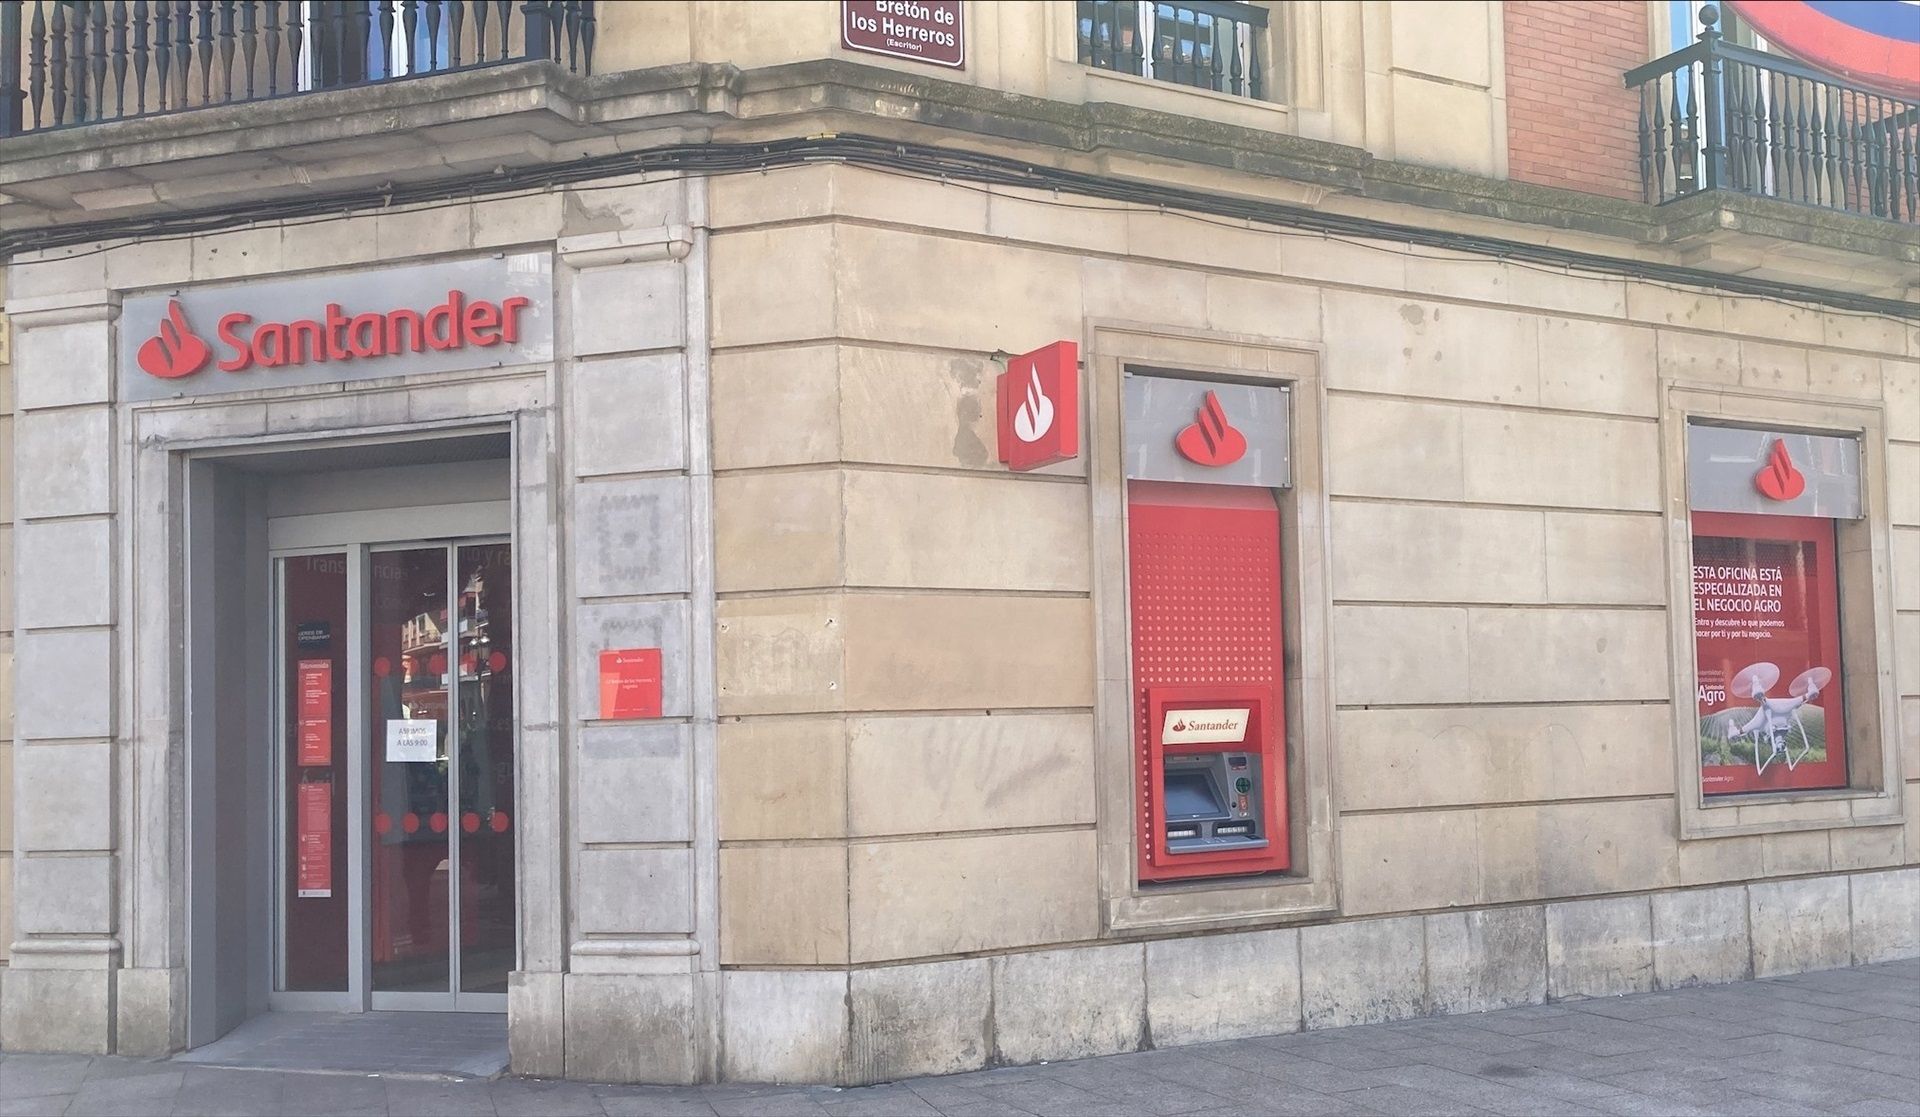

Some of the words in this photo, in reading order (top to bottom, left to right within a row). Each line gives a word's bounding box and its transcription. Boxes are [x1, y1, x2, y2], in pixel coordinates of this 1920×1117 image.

[875, 0, 930, 21] Bretón
[934, 7, 955, 26] de
[851, 11, 878, 32] los
[882, 17, 954, 47] Herreros
[886, 38, 922, 52] (Escritor)
[217, 289, 529, 372] Santander
[1693, 566, 1716, 579] ESTA
[1718, 566, 1758, 581] OFICINA
[1759, 566, 1783, 582] ESTÁ
[1693, 582, 1768, 597] ESPECIALIZADA
[1769, 584, 1783, 597] EN
[1694, 598, 1706, 611] EL
[1707, 598, 1752, 612] NEGOCIO
[1754, 600, 1781, 612] AGRO
[1714, 618, 1740, 626] descubre
[1759, 620, 1784, 628] podemos
[1711, 630, 1721, 639] por
[1731, 630, 1741, 639] por
[1749, 630, 1772, 639] negocio.
[1698, 685, 1726, 706] Agro
[1188, 719, 1238, 731] Santander
